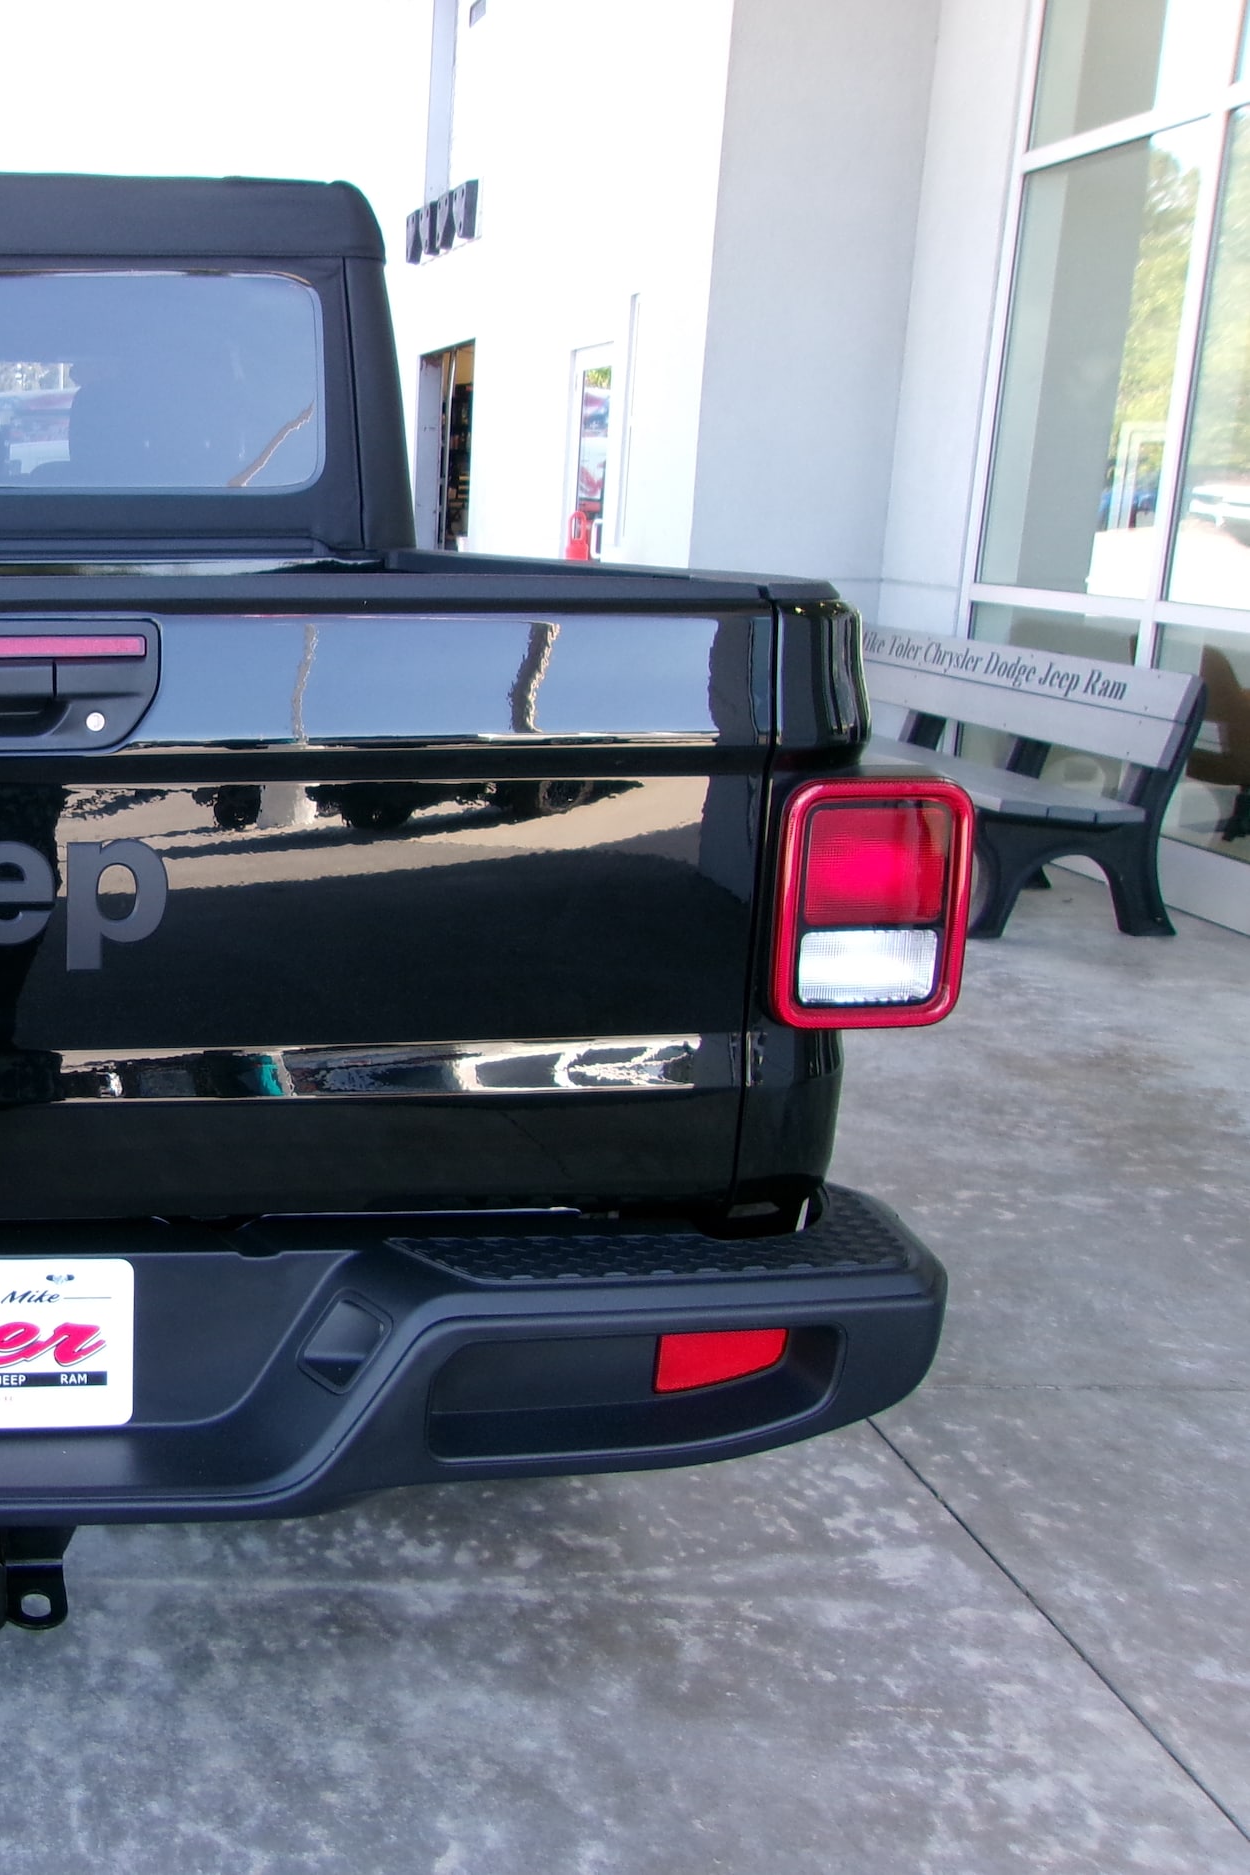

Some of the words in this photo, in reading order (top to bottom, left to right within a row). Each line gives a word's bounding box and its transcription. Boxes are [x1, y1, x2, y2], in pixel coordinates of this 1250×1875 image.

[859, 631, 885, 654] ike
[888, 634, 922, 660] Toler
[924, 641, 983, 674] Chrysler
[983, 652, 1037, 687] Dodge
[1038, 662, 1081, 697] Jeep
[1081, 669, 1127, 700] Ram
[1, 1290, 60, 1304] Mike
[60, 1374, 88, 1385] RAM
